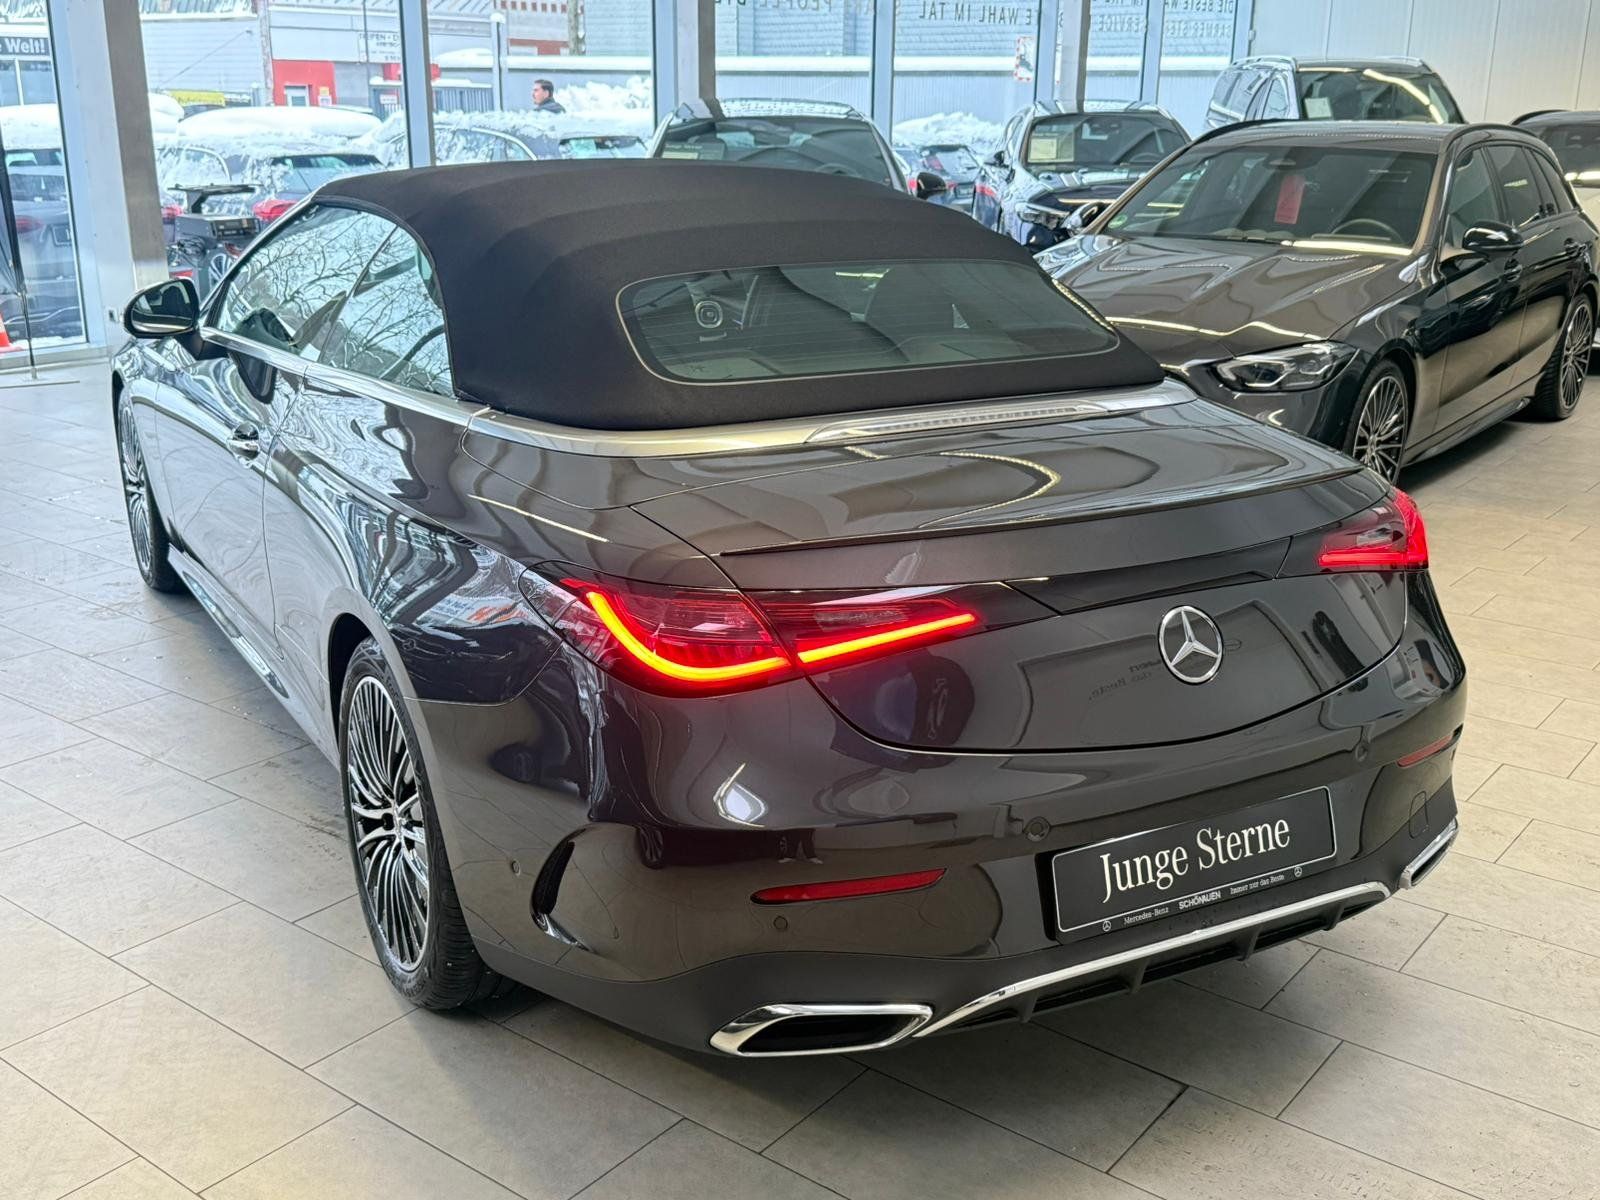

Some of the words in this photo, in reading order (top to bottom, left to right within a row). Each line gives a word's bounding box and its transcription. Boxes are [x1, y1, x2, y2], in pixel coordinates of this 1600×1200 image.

[4, 38, 46, 54] Welt!
[1100, 845, 1190, 904] Junge
[1195, 818, 1291, 871] Sterne
[1123, 906, 1170, 925] Mercedes-Benz
[1178, 890, 1222, 910] SCHÖNAUEN
